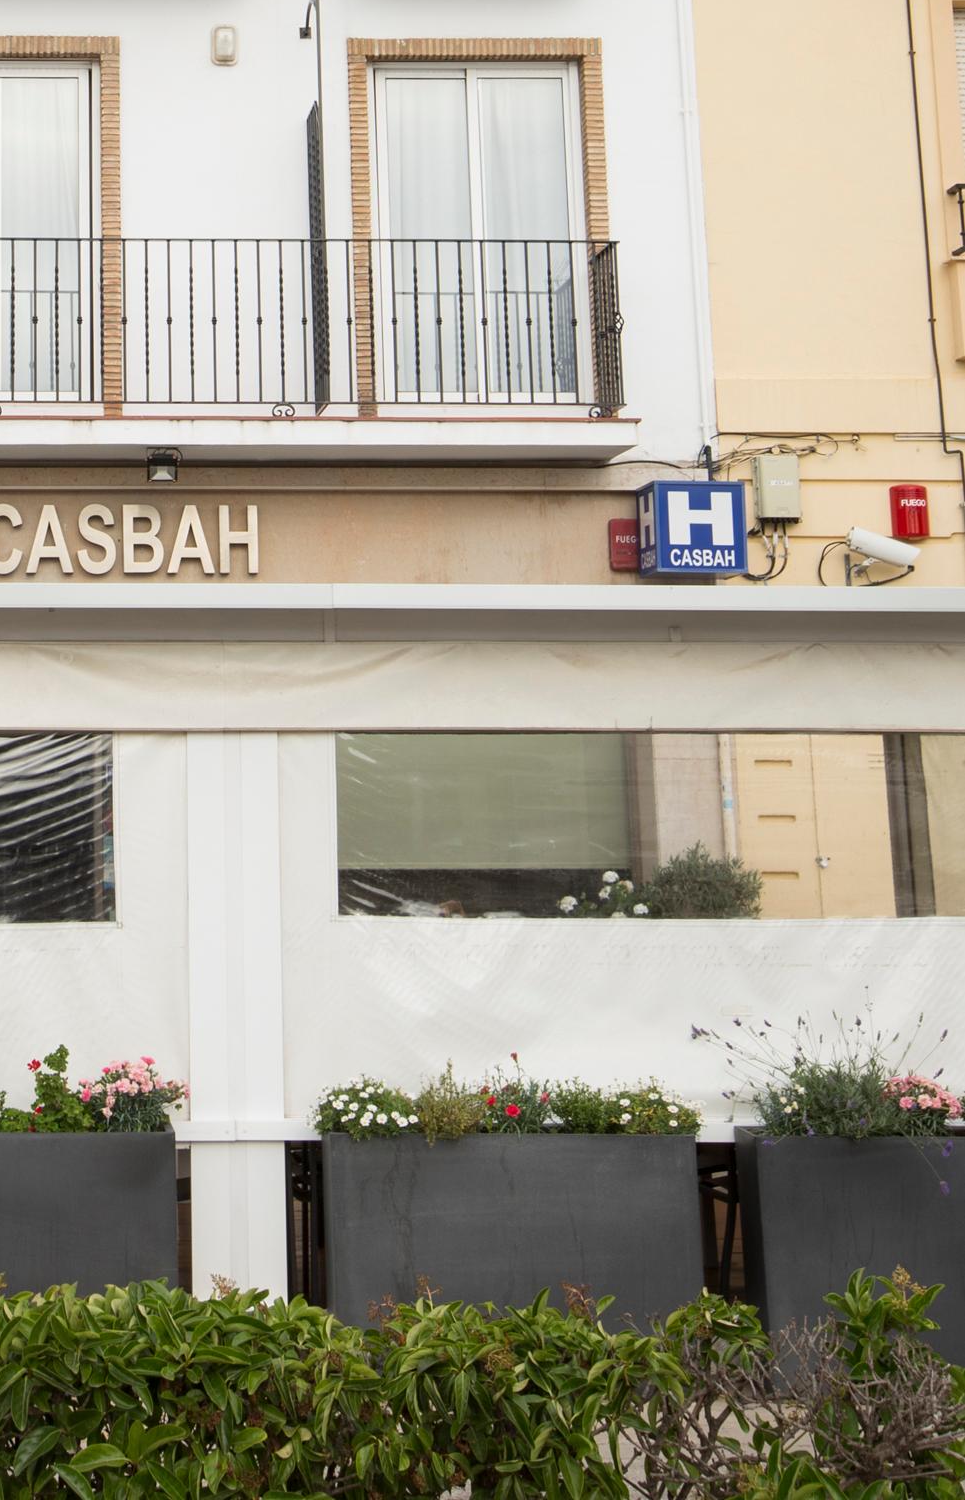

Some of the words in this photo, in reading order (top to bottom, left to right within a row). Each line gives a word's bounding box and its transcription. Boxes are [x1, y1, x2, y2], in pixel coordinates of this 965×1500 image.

[900, 499, 926, 507] FUEGO
[638, 492, 655, 548] H
[667, 491, 734, 546] H
[615, 534, 637, 543] FUEG
[670, 548, 736, 567] CASBAH
